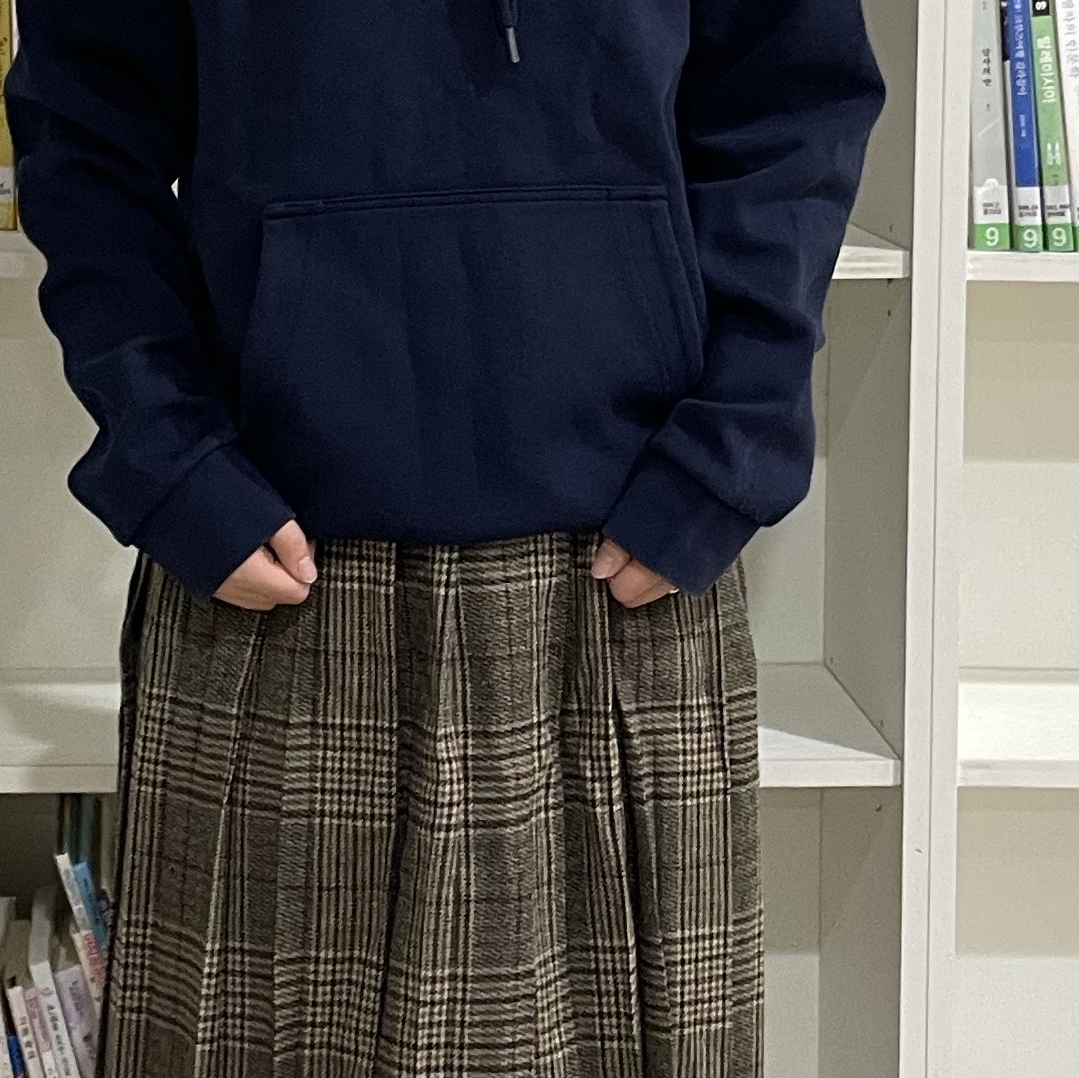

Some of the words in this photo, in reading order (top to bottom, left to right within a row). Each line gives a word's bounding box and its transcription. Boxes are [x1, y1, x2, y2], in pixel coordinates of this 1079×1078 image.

[1037, 36, 1057, 103] 말레이시아
[985, 226, 999, 247] 9
[1023, 228, 1038, 248] 9
[1051, 227, 1067, 247] 9
